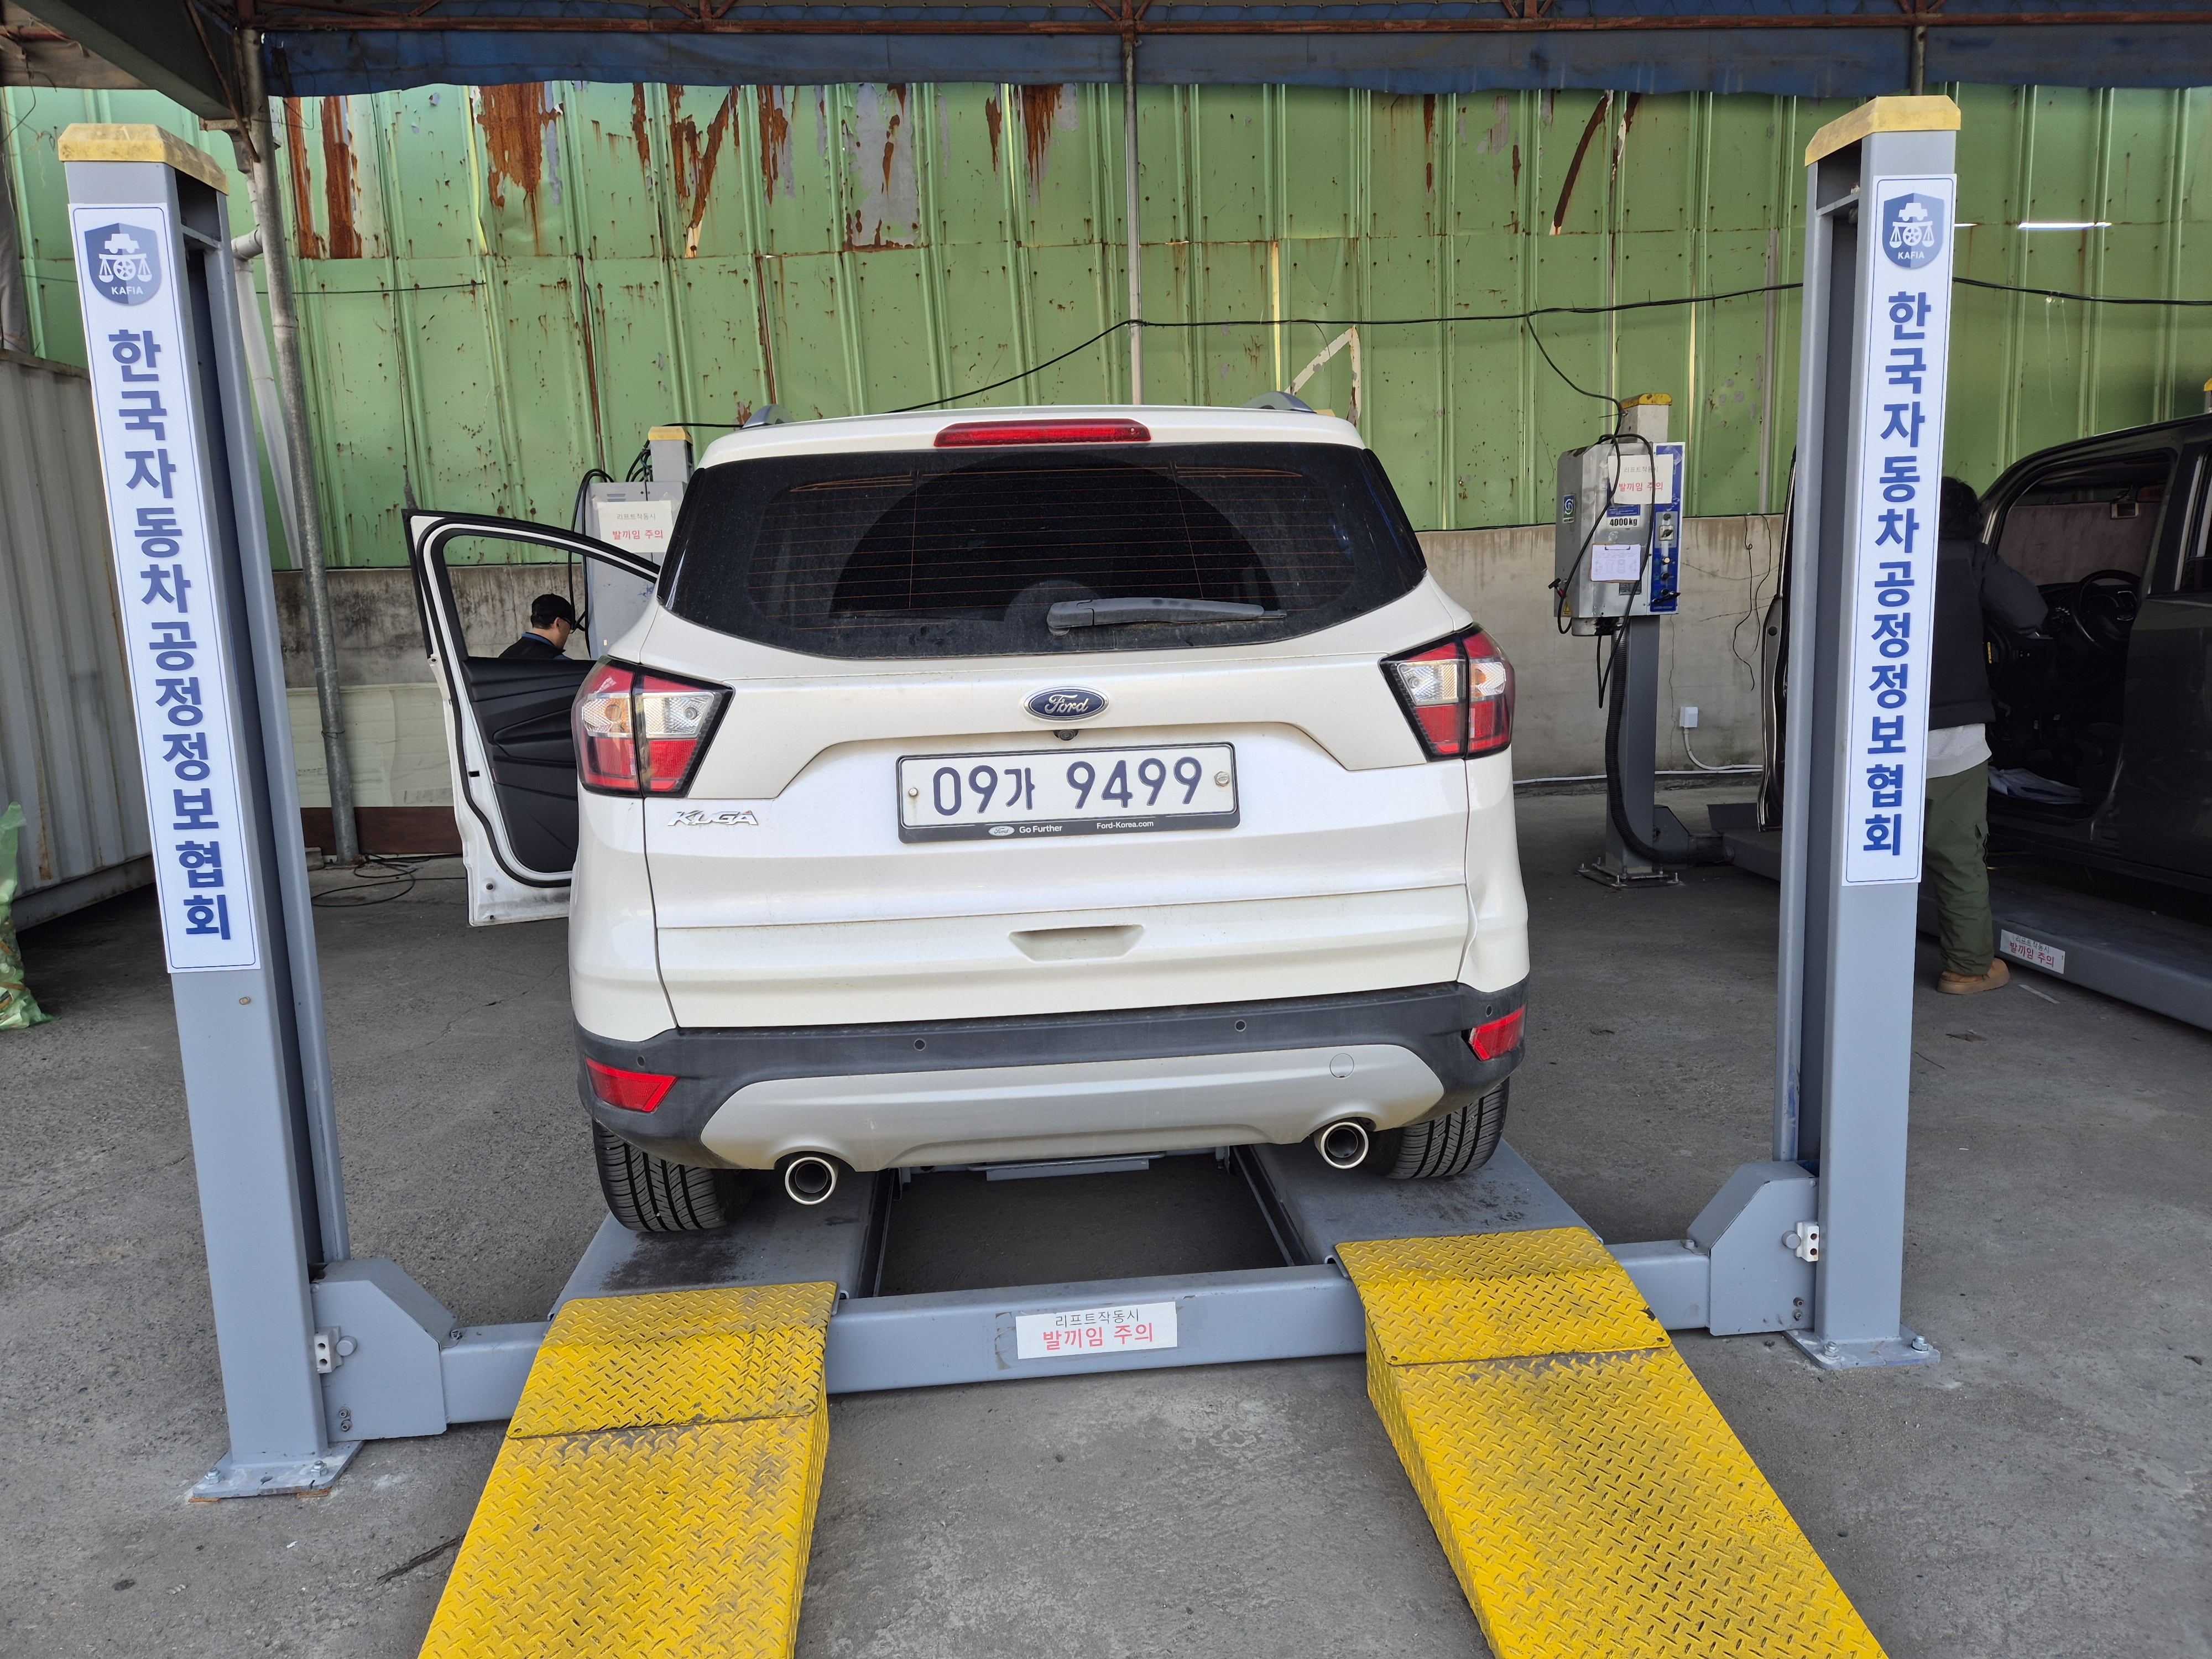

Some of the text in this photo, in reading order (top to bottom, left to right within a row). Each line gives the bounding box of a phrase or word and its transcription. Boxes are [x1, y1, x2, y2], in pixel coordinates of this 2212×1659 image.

[1898, 251, 1924, 259] KAFIA
[111, 286, 143, 295] KAFIA
[1619, 482, 1663, 492] 발끼임 주의
[612, 529, 663, 540] 발끼임 주의
[1863, 290, 1932, 855] 한국자동차공정정보협회
[108, 328, 231, 940] 한국자동차공정정보협회
[1044, 694, 1089, 714] Ford
[932, 756, 1203, 816] 09가 9499
[667, 810, 759, 826] KUGA
[1097, 821, 1154, 830] Ford-Korea.com
[994, 826, 1009, 835] Ford
[1019, 824, 1062, 834] Go Further
[2015, 935, 2049, 953] 리프트작동시
[2010, 941, 2054, 967] 발끼임 주의
[1055, 1308, 1139, 1328] 리프트작동시
[1043, 1322, 1153, 1350] 발끼임 주의
